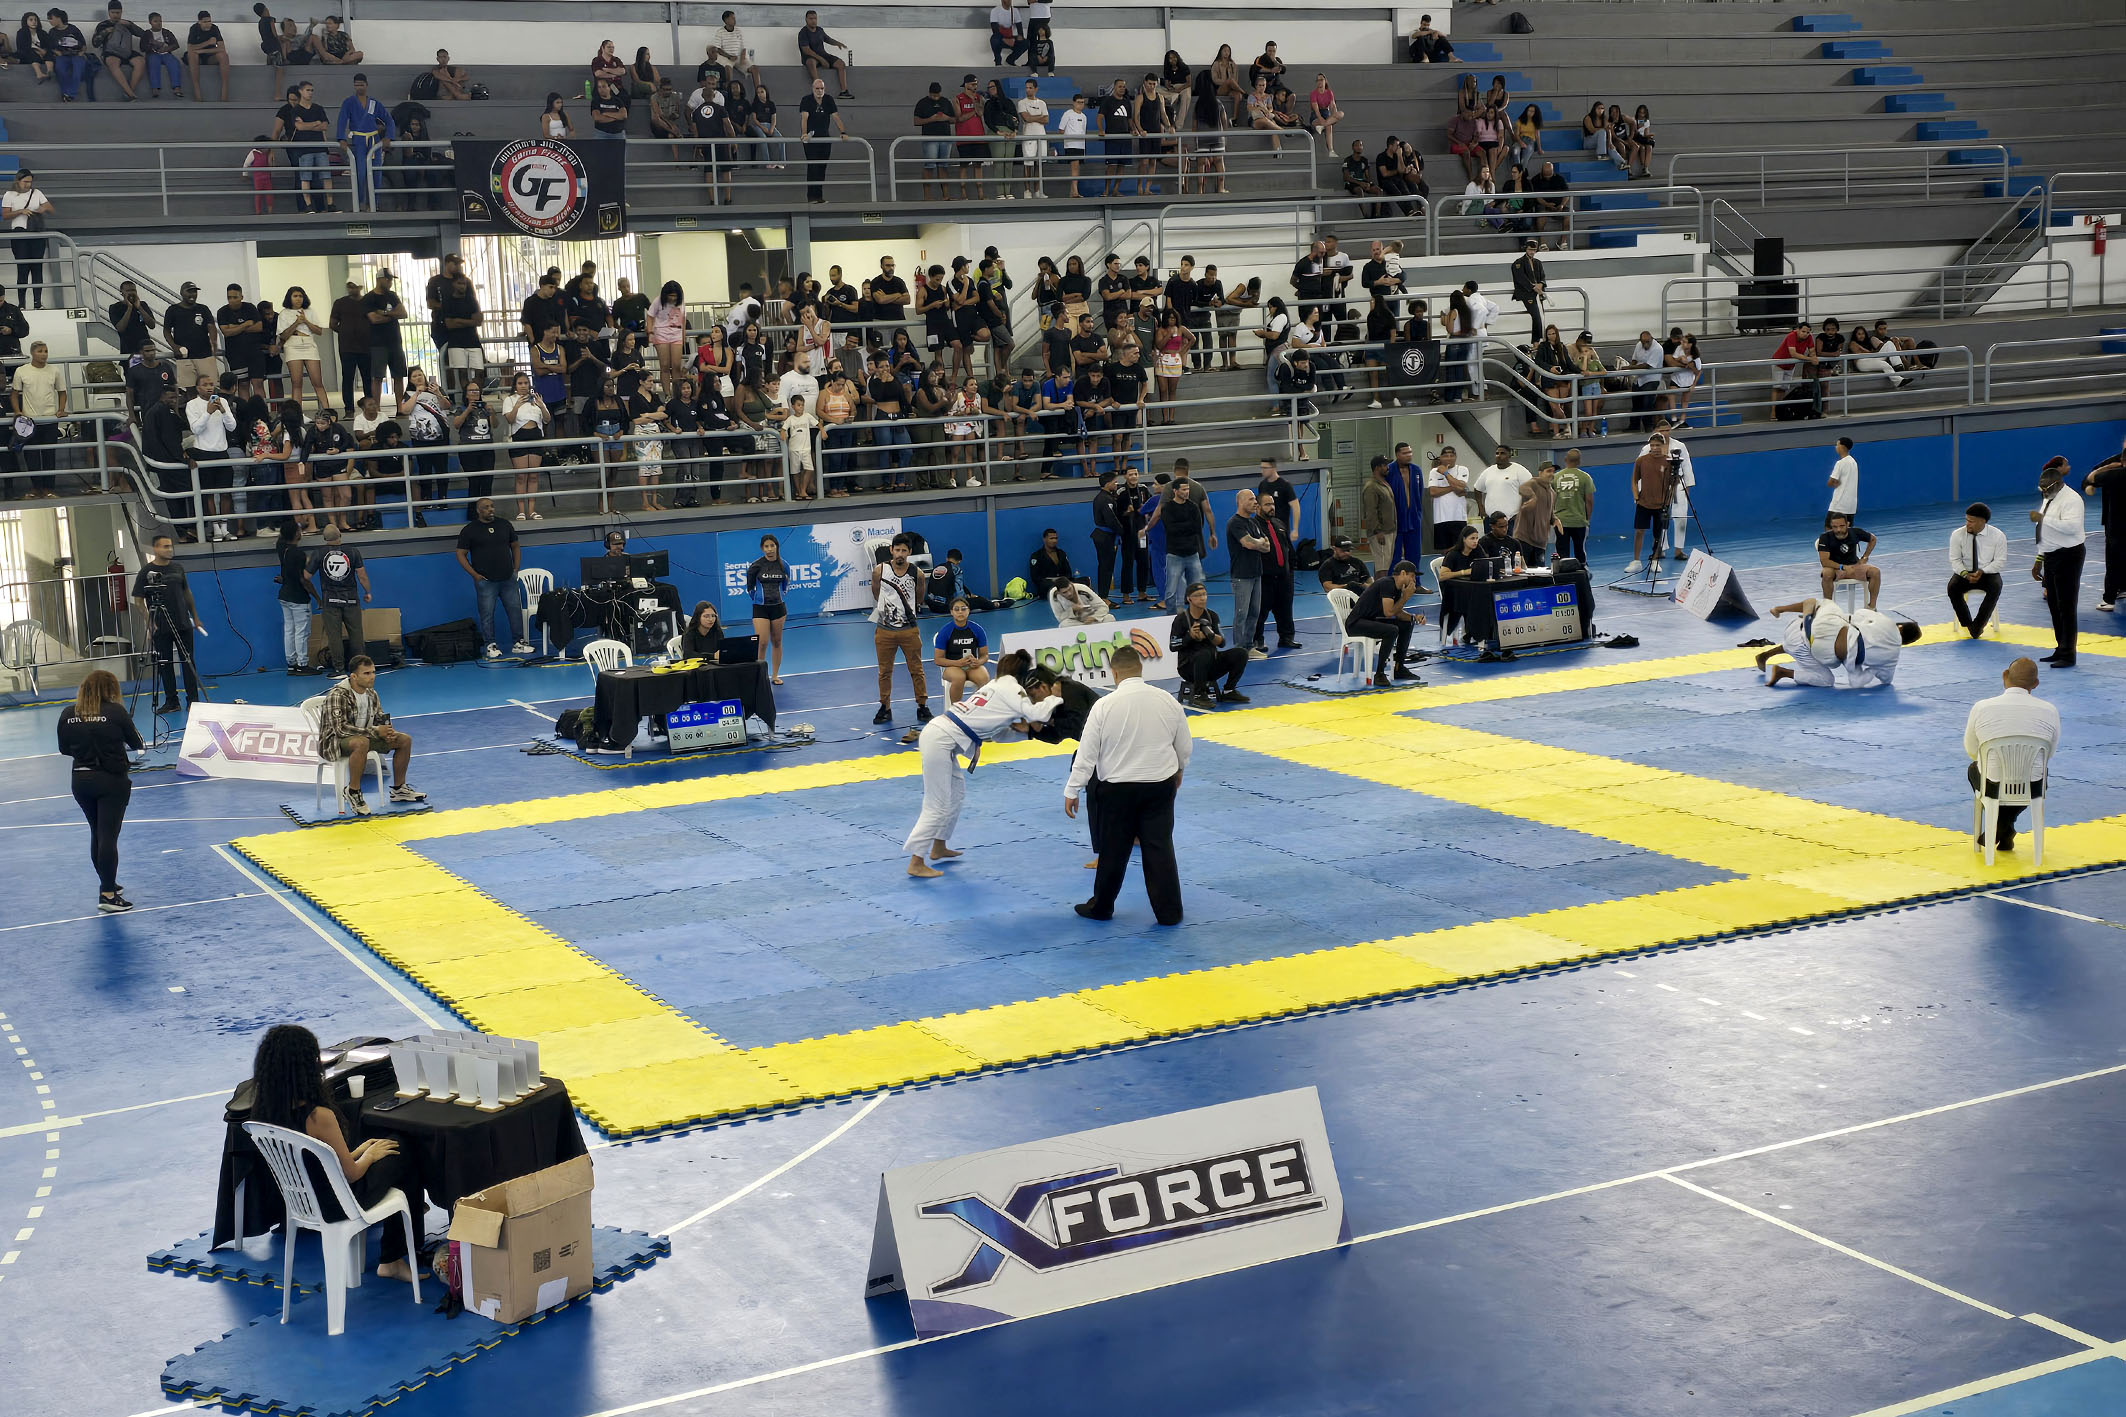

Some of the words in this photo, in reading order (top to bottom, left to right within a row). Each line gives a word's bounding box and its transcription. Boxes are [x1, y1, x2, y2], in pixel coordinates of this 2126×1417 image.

[867, 525, 896, 537] Macaé
[724, 561, 753, 569] Secret
[188, 720, 319, 761] XFORC
[917, 1147, 1310, 1299] XFORCE
